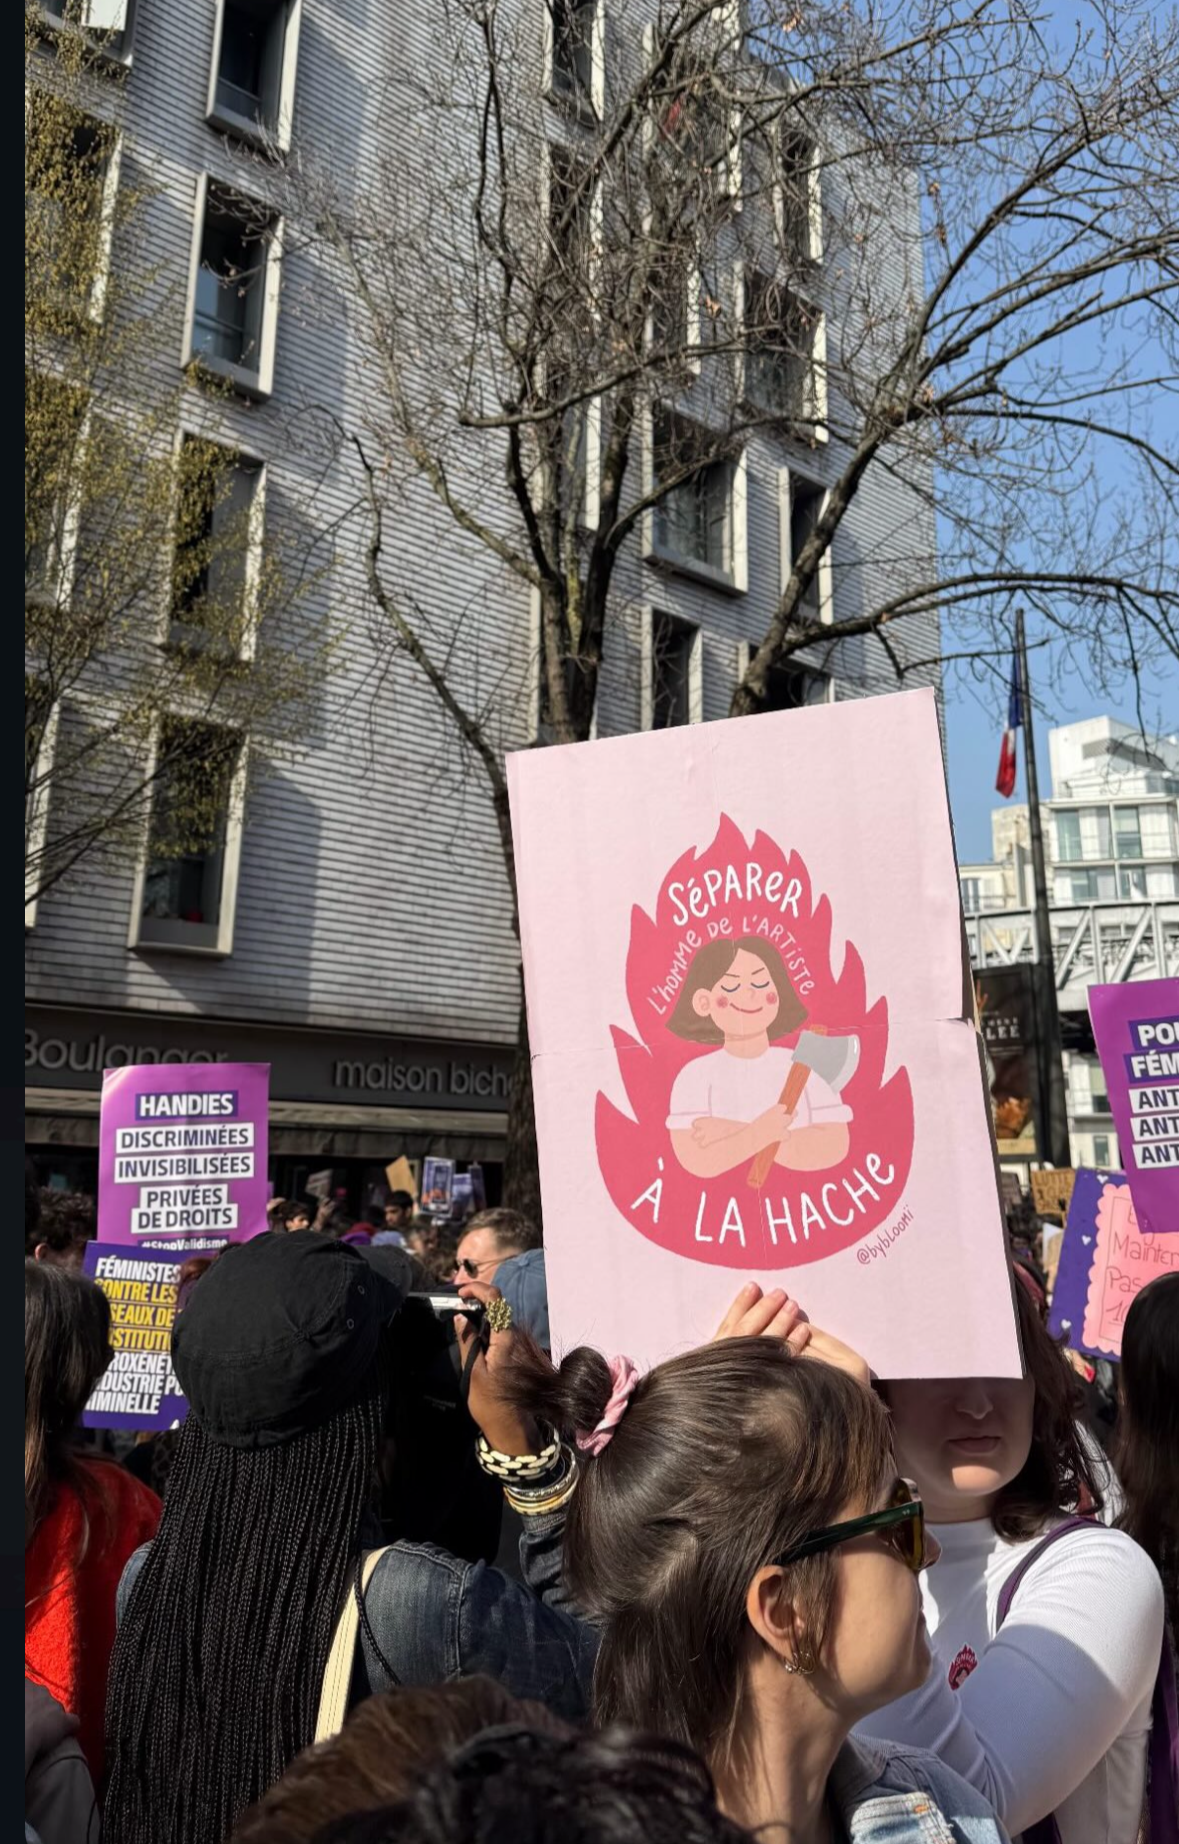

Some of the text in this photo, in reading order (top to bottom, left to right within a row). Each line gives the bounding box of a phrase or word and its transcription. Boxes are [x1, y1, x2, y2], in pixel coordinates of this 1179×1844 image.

[335, 1057, 442, 1093] maison
[140, 1093, 234, 1117] HANDIES
[121, 1124, 249, 1149] DISCRIMINÉES
[118, 1152, 251, 1179] INVISIBILISÉES
[147, 1183, 223, 1208] PRIVÉES
[138, 1207, 232, 1230] DE DROITS
[694, 1190, 746, 1247] LA
[95, 1254, 181, 1284] FÉMINISTES
[151, 1283, 178, 1304] LES
[155, 1308, 175, 1328] DE
[96, 1371, 164, 1395] DUSTRIE
